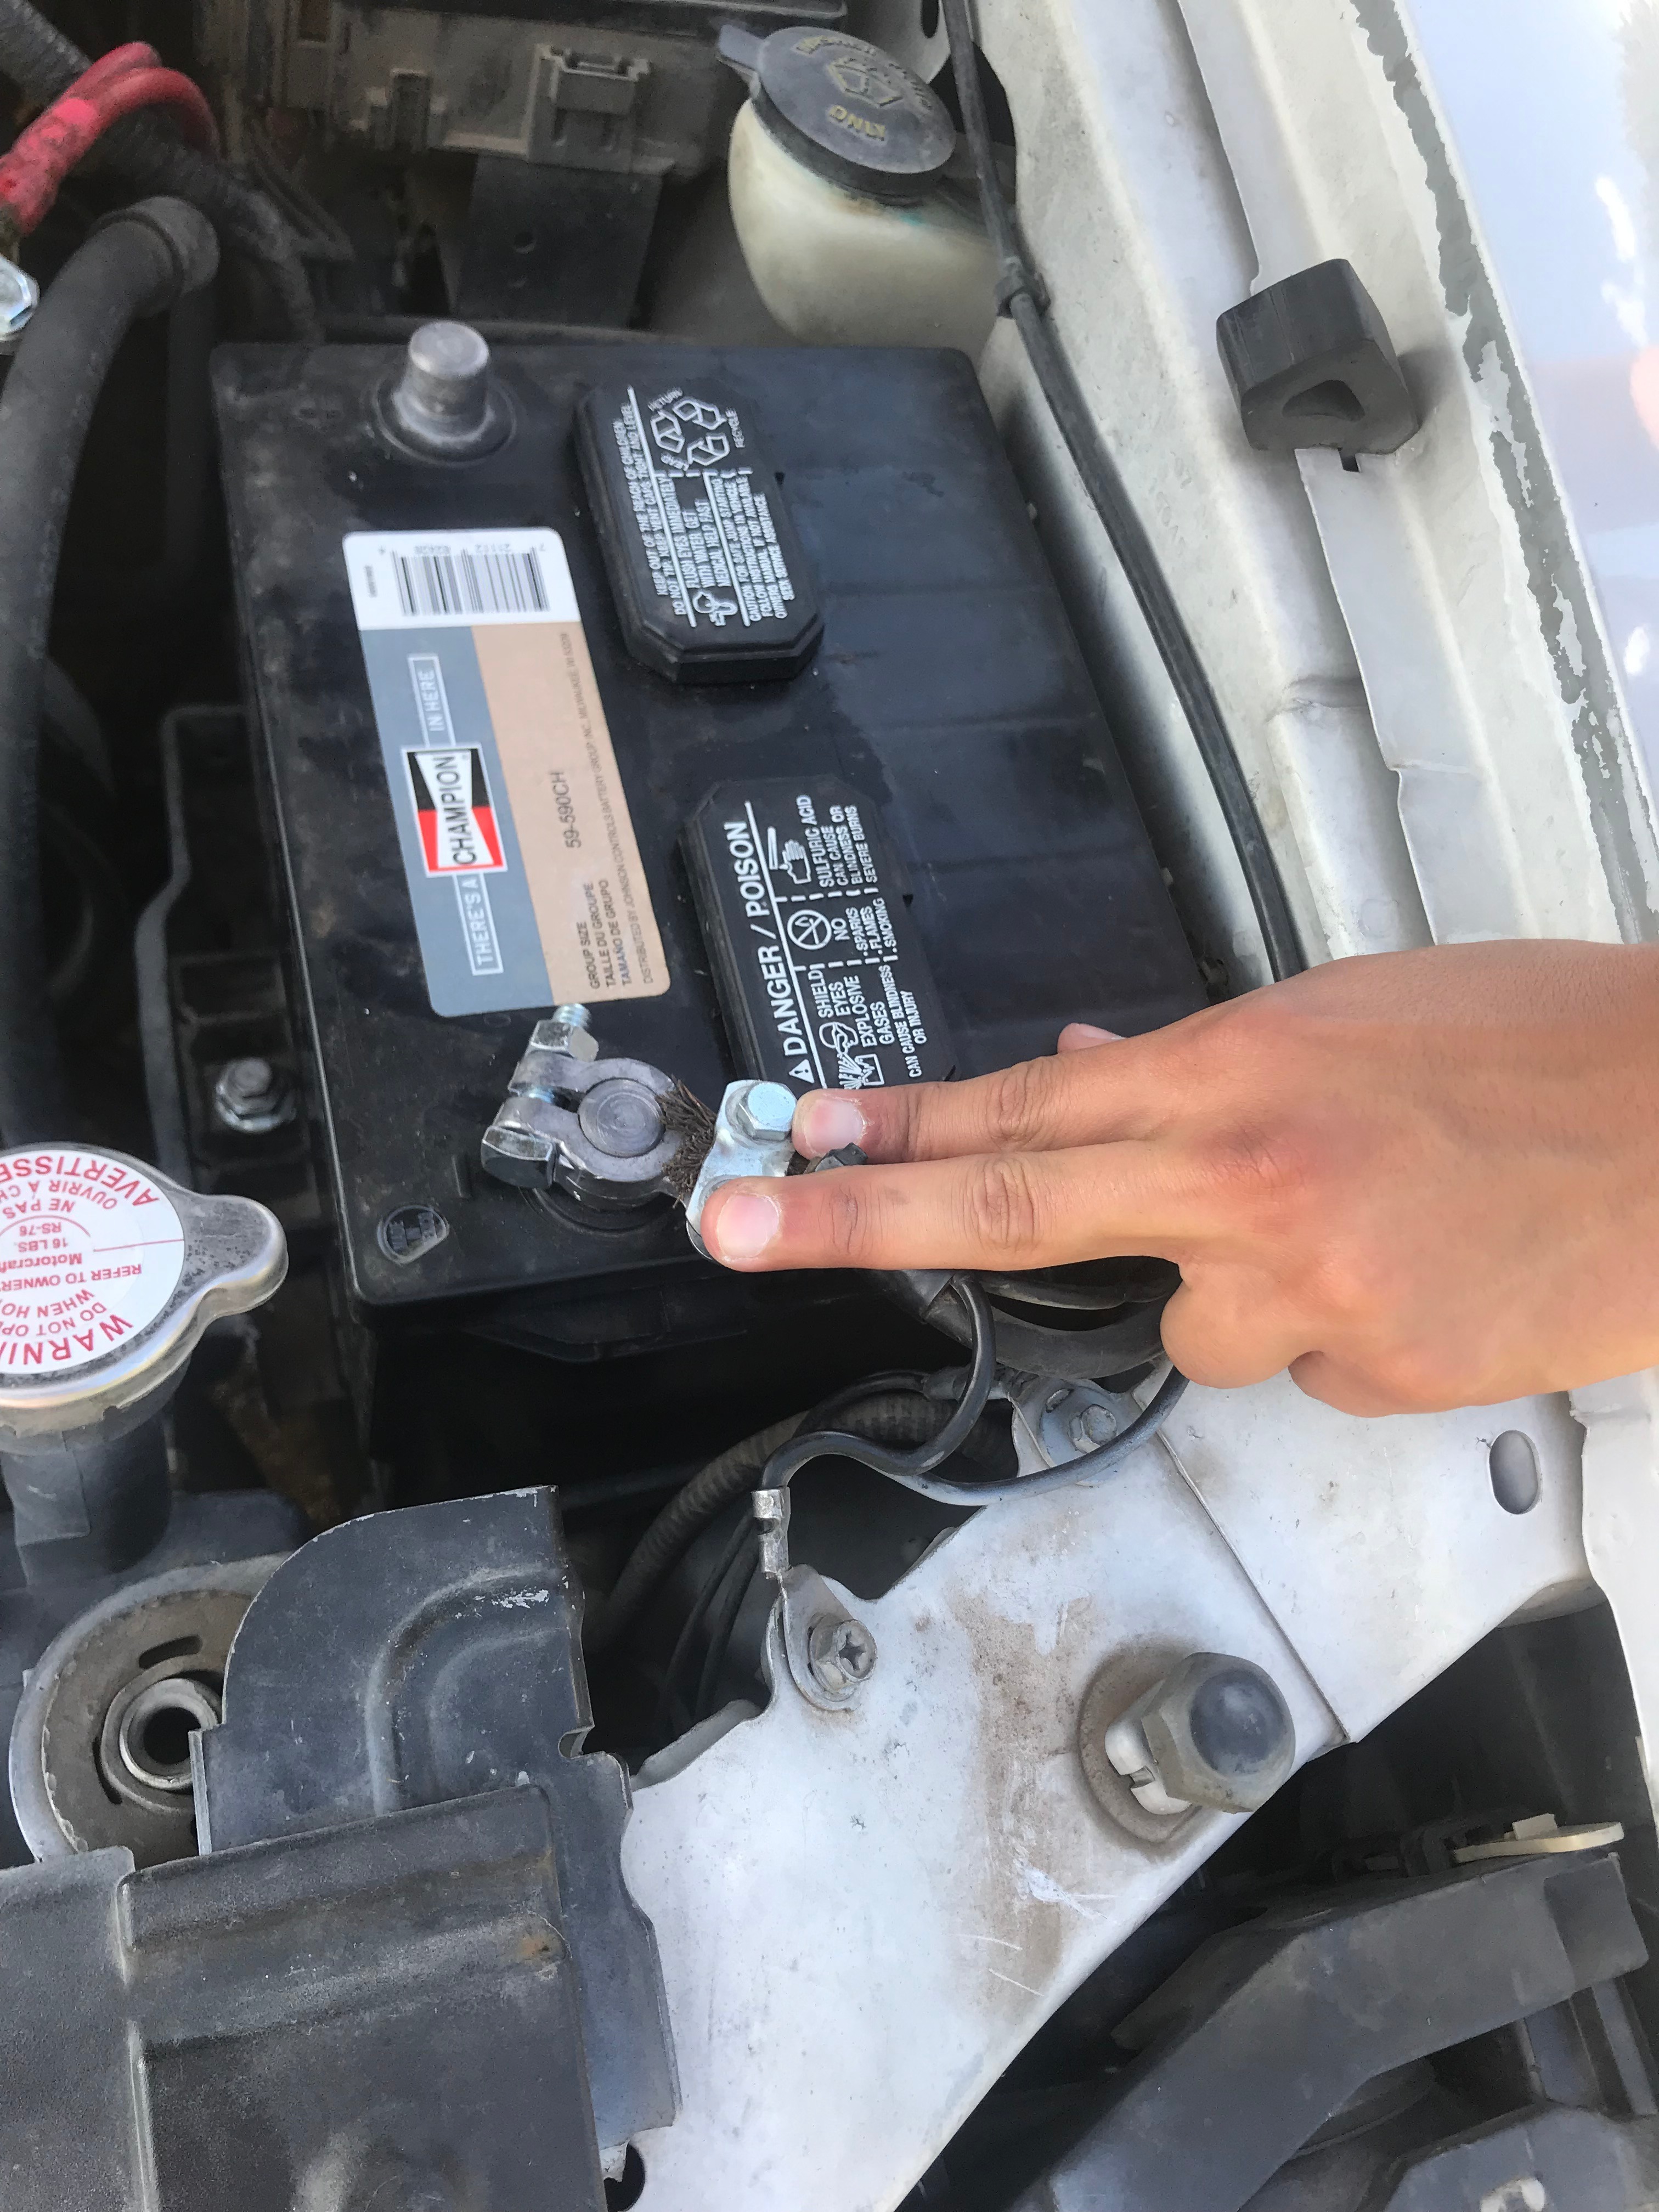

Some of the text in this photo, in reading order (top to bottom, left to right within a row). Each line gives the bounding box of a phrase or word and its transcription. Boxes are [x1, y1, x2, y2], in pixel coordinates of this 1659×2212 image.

[829, 105, 885, 140] ONLY
[628, 431, 641, 450] AND
[624, 466, 637, 479] OF
[633, 453, 648, 478] TIGHT
[628, 481, 645, 511] REACH
[641, 480, 656, 505] CAPS
[637, 513, 651, 532] THE
[648, 507, 662, 531] VENT
[659, 477, 699, 588] FLUSH EYES IMMEDIATELY
[684, 511, 699, 528] GET
[724, 520, 738, 541] JUMP
[748, 520, 761, 536] NOT
[642, 532, 655, 547] OF
[654, 532, 669, 556] KEEP
[702, 524, 720, 546] HELP
[725, 482, 772, 616] FOLLOW INSTRUCTIONS IN VEHICLE
[647, 550, 662, 569] OUT
[709, 550, 731, 586] MEDICAL
[730, 543, 744, 563] SAFE
[769, 545, 788, 578] SERVICE
[653, 571, 668, 595] KEEP
[667, 580, 681, 597] NOT
[698, 565, 715, 588] WITH
[736, 565, 750, 582] FOR
[779, 580, 794, 600] SEEK
[673, 600, 686, 614] DO
[419, 669, 444, 731] IN HERE
[433, 753, 477, 866] CHAMPION
[595, 775, 611, 813] BATTERY
[550, 771, 580, 849] 59-590CH
[603, 814, 623, 862] CONTROLS
[797, 795, 836, 888] SULFURIC ACID
[830, 805, 862, 884] BLINDNESS OR
[845, 805, 878, 883] SEVERE BURNS
[725, 821, 771, 917] POISON
[822, 825, 849, 885] CAN CAUSE
[616, 864, 634, 909] JOHNSON
[462, 877, 493, 965] THERE'S A
[628, 910, 637, 921] BY
[831, 917, 850, 940] NO
[584, 882, 615, 988] TAILLE DU GROUPE
[599, 878, 631, 986] TAMAÑO DE GRUPO
[577, 921, 600, 990] GROUP SIZE
[630, 922, 653, 984] DISTRIBUTED
[758, 945, 808, 1056] DANGER
[809, 969, 834, 1018] SHIELD
[829, 981, 851, 1016] EYES
[845, 975, 877, 1047] EXPLOSIVE
[871, 1001, 895, 1044] GASES
[879, 964, 922, 1077] CAN CAUSE BLINDNESS
[902, 990, 927, 1044] OR INJURY
[2, 1198, 75, 1219] NE PAS
[48, 1180, 117, 1209] OUVRIR
[19, 1222, 61, 1236] RS-76
[52, 1238, 68, 1249] 16
[0, 1264, 142, 1291] REFER TO OWNER
[0, 1289, 94, 1318] WHEN HO
[0, 1302, 106, 1337] DO NOT OP
